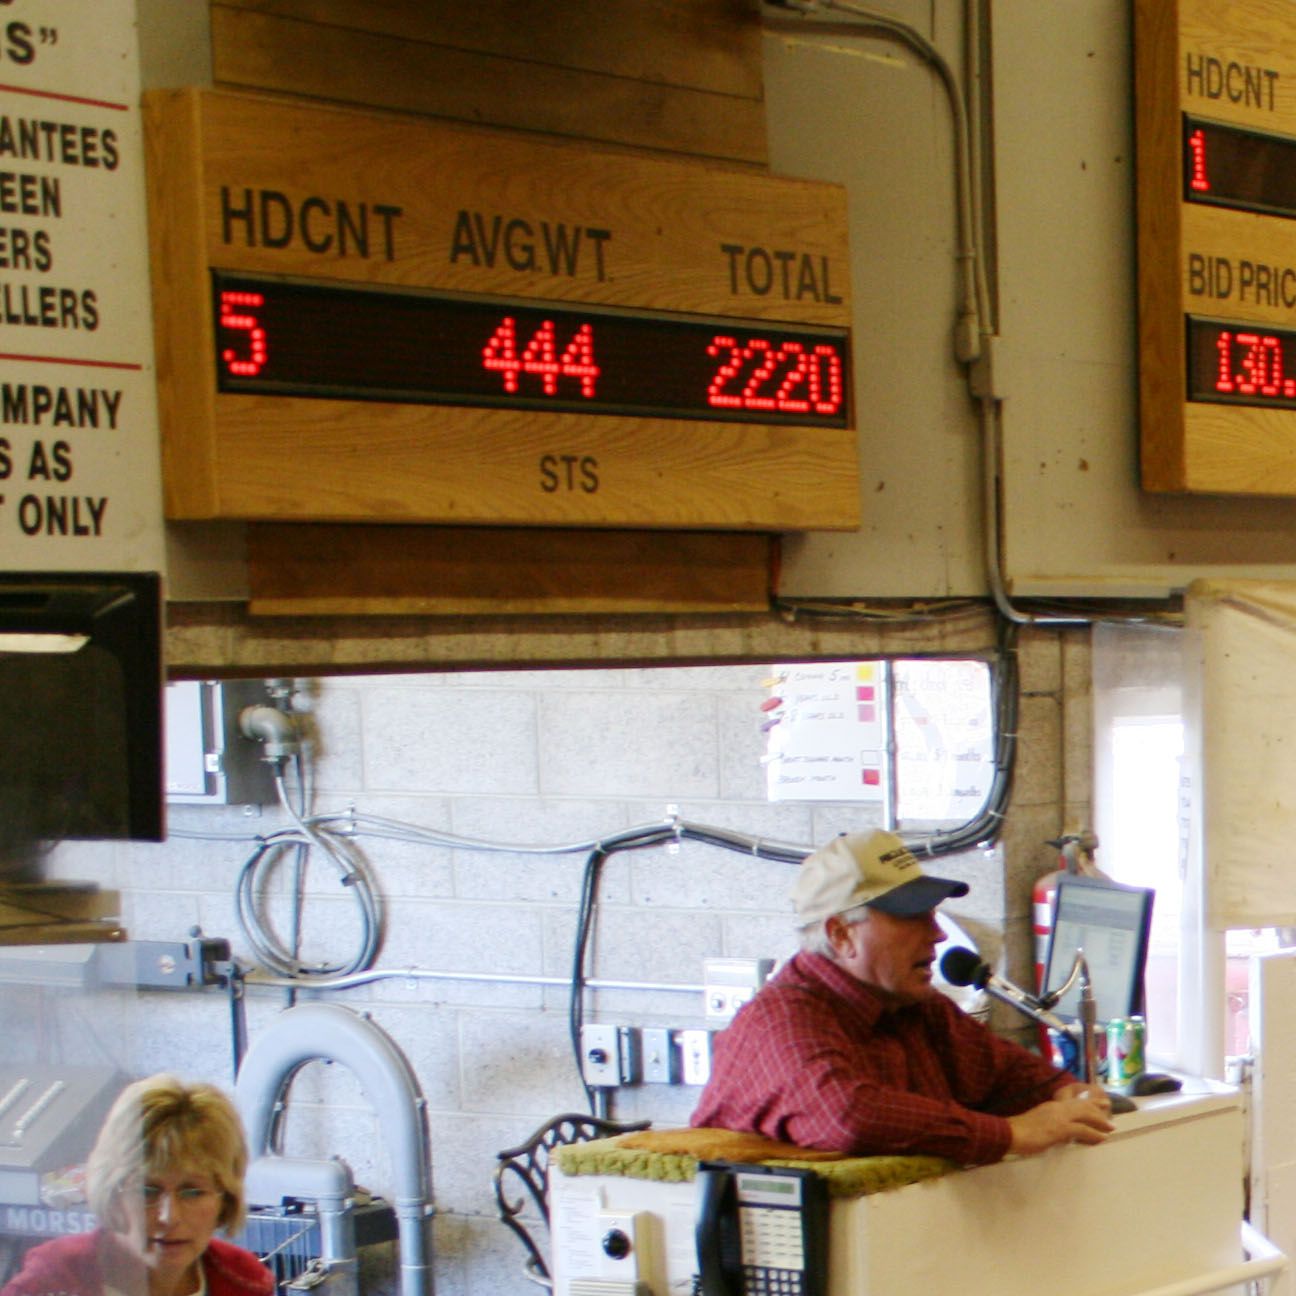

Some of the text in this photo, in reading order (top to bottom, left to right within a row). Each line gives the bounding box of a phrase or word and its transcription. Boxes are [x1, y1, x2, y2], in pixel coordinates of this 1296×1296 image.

[1187, 52, 1279, 112] HDCNT
[1189, 129, 1209, 191] 1
[220, 186, 403, 261] HDCNT
[720, 243, 843, 304] TOTAL
[1188, 253, 1233, 299] BID
[0, 284, 98, 331] LLERS
[220, 290, 842, 414] 5 444 2220
[2, 383, 122, 429] MPANY
[28, 440, 72, 482] AS
[538, 455, 600, 494] STS
[19, 494, 108, 536] ONLY
